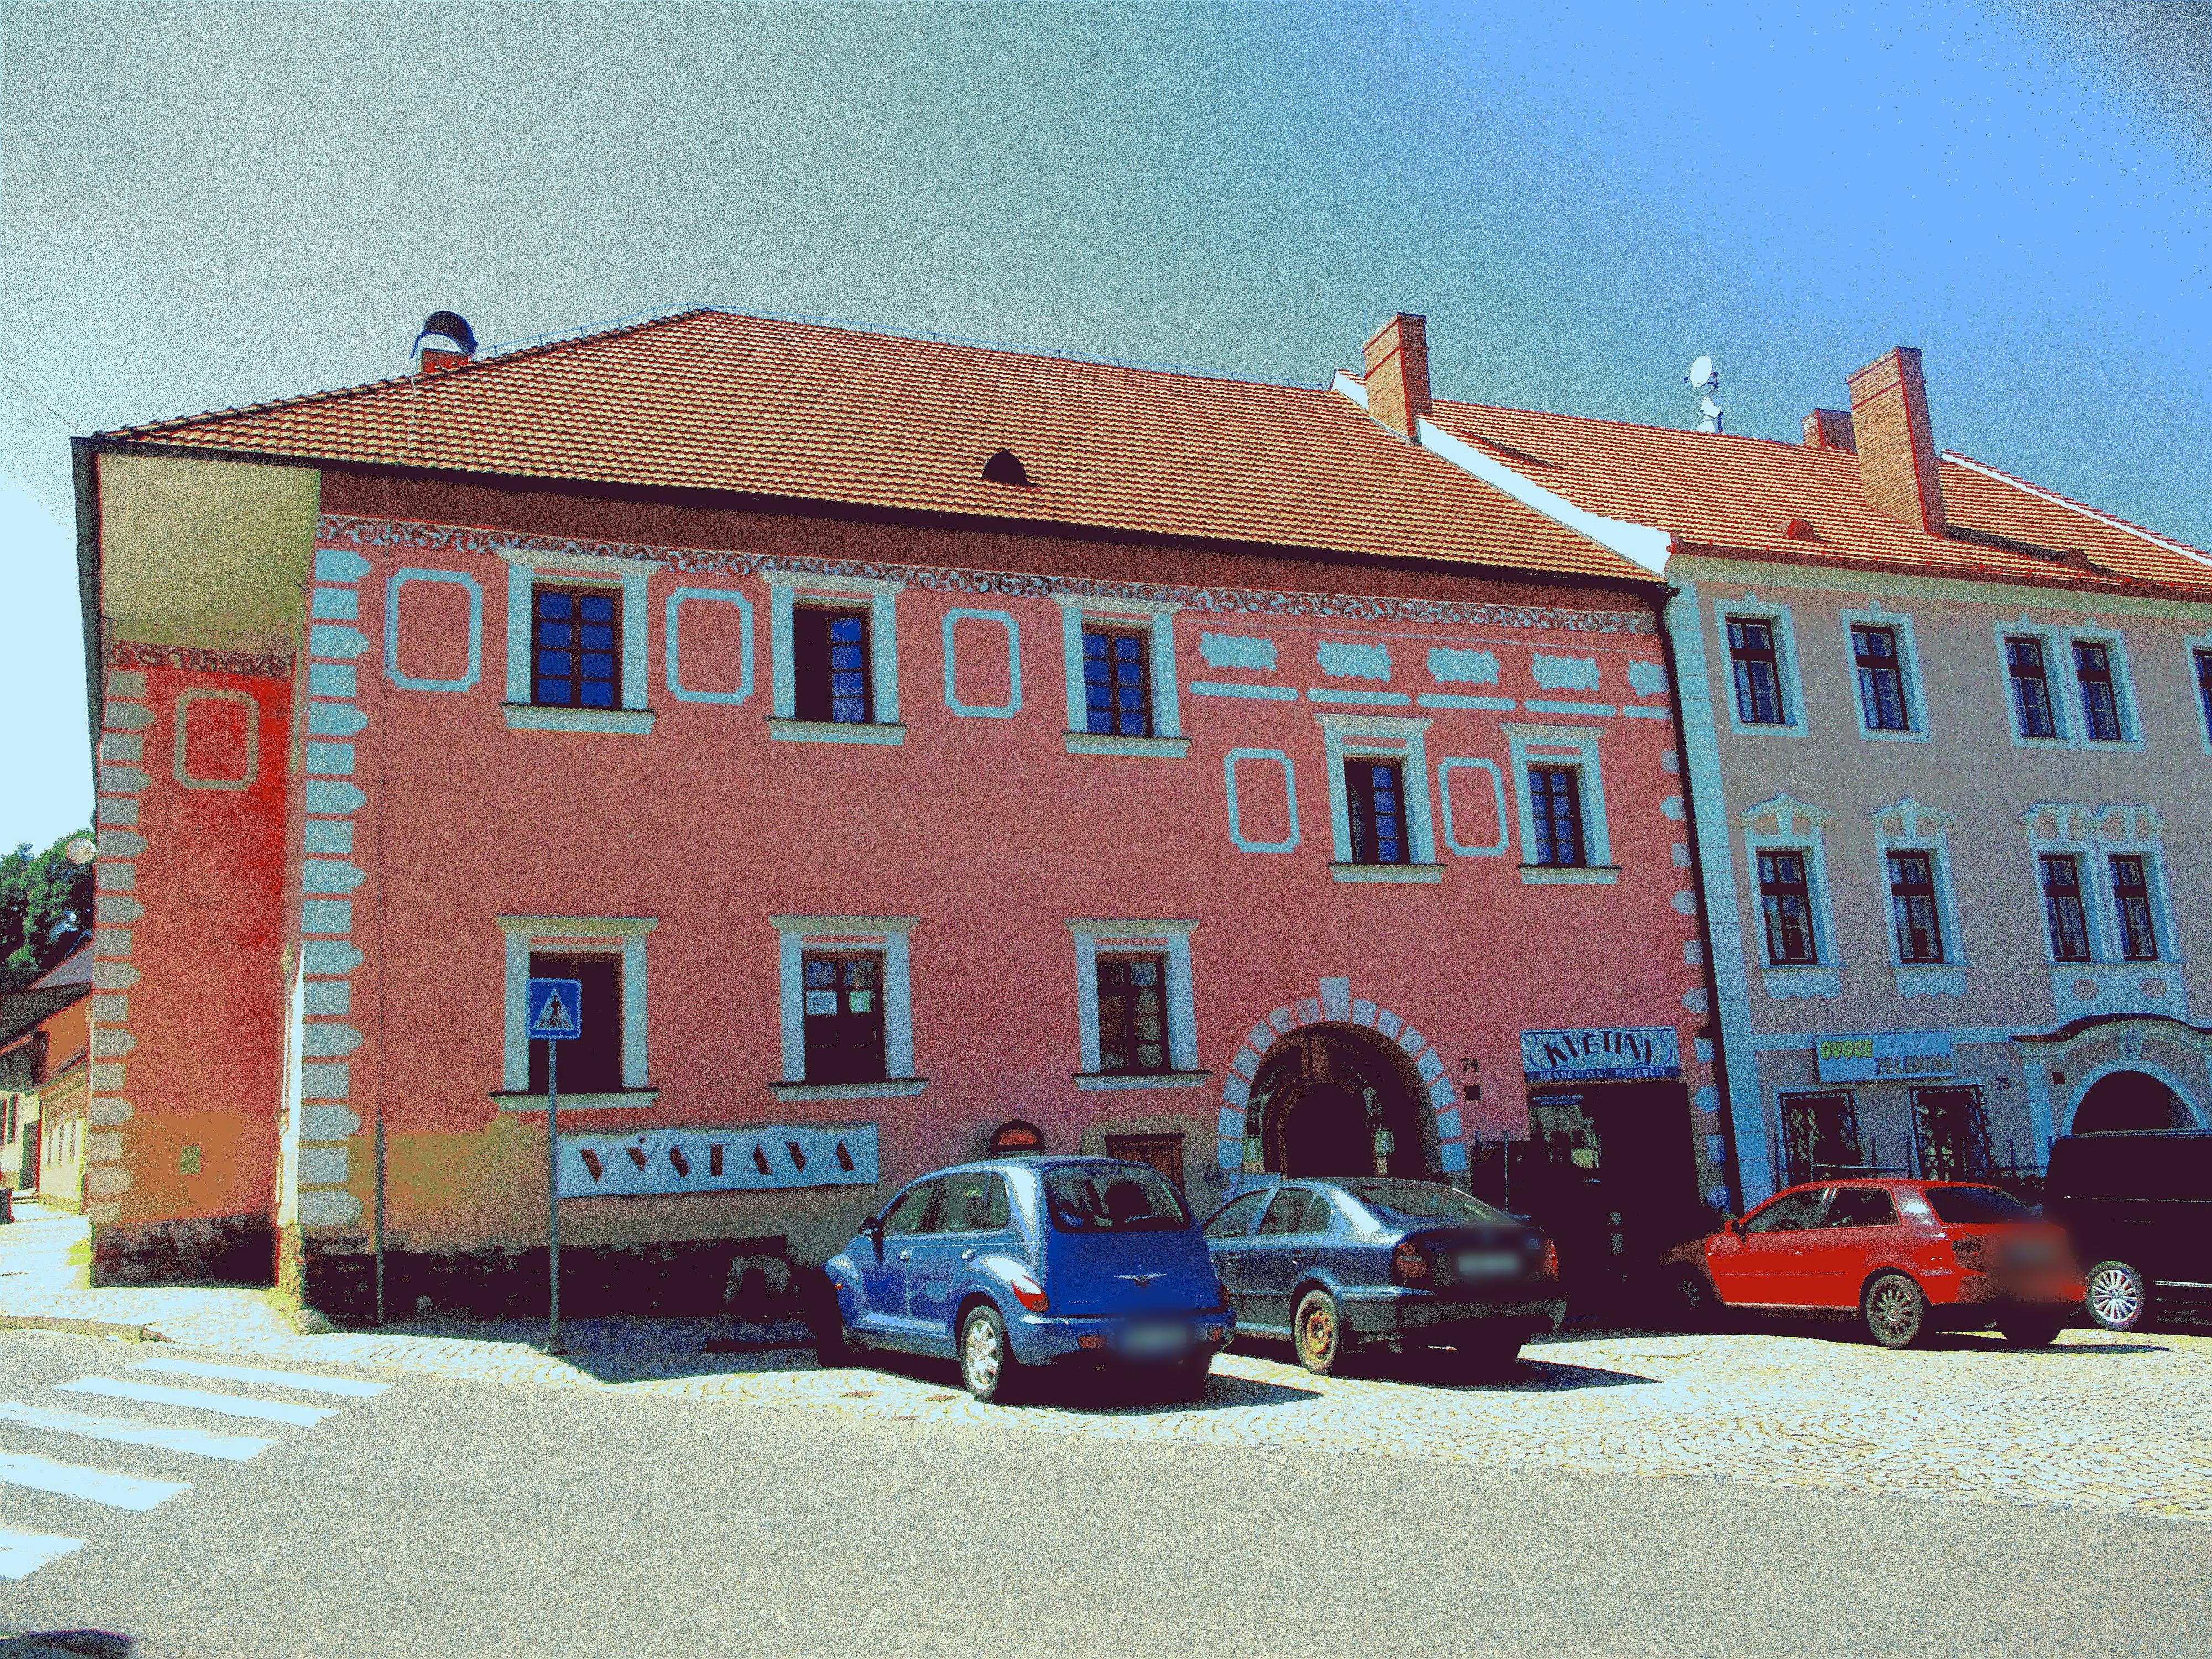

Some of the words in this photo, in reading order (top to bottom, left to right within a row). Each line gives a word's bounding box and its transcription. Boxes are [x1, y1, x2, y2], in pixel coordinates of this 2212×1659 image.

[1543, 1031, 1658, 1067] KVĚTINY
[1820, 1039, 1873, 1060] OVOCE
[1460, 1057, 1479, 1072] 74
[1875, 1053, 1953, 1076] ZELENINA
[1995, 1078, 2011, 1091] 75
[578, 1136, 857, 1185] VÝSTAVA
